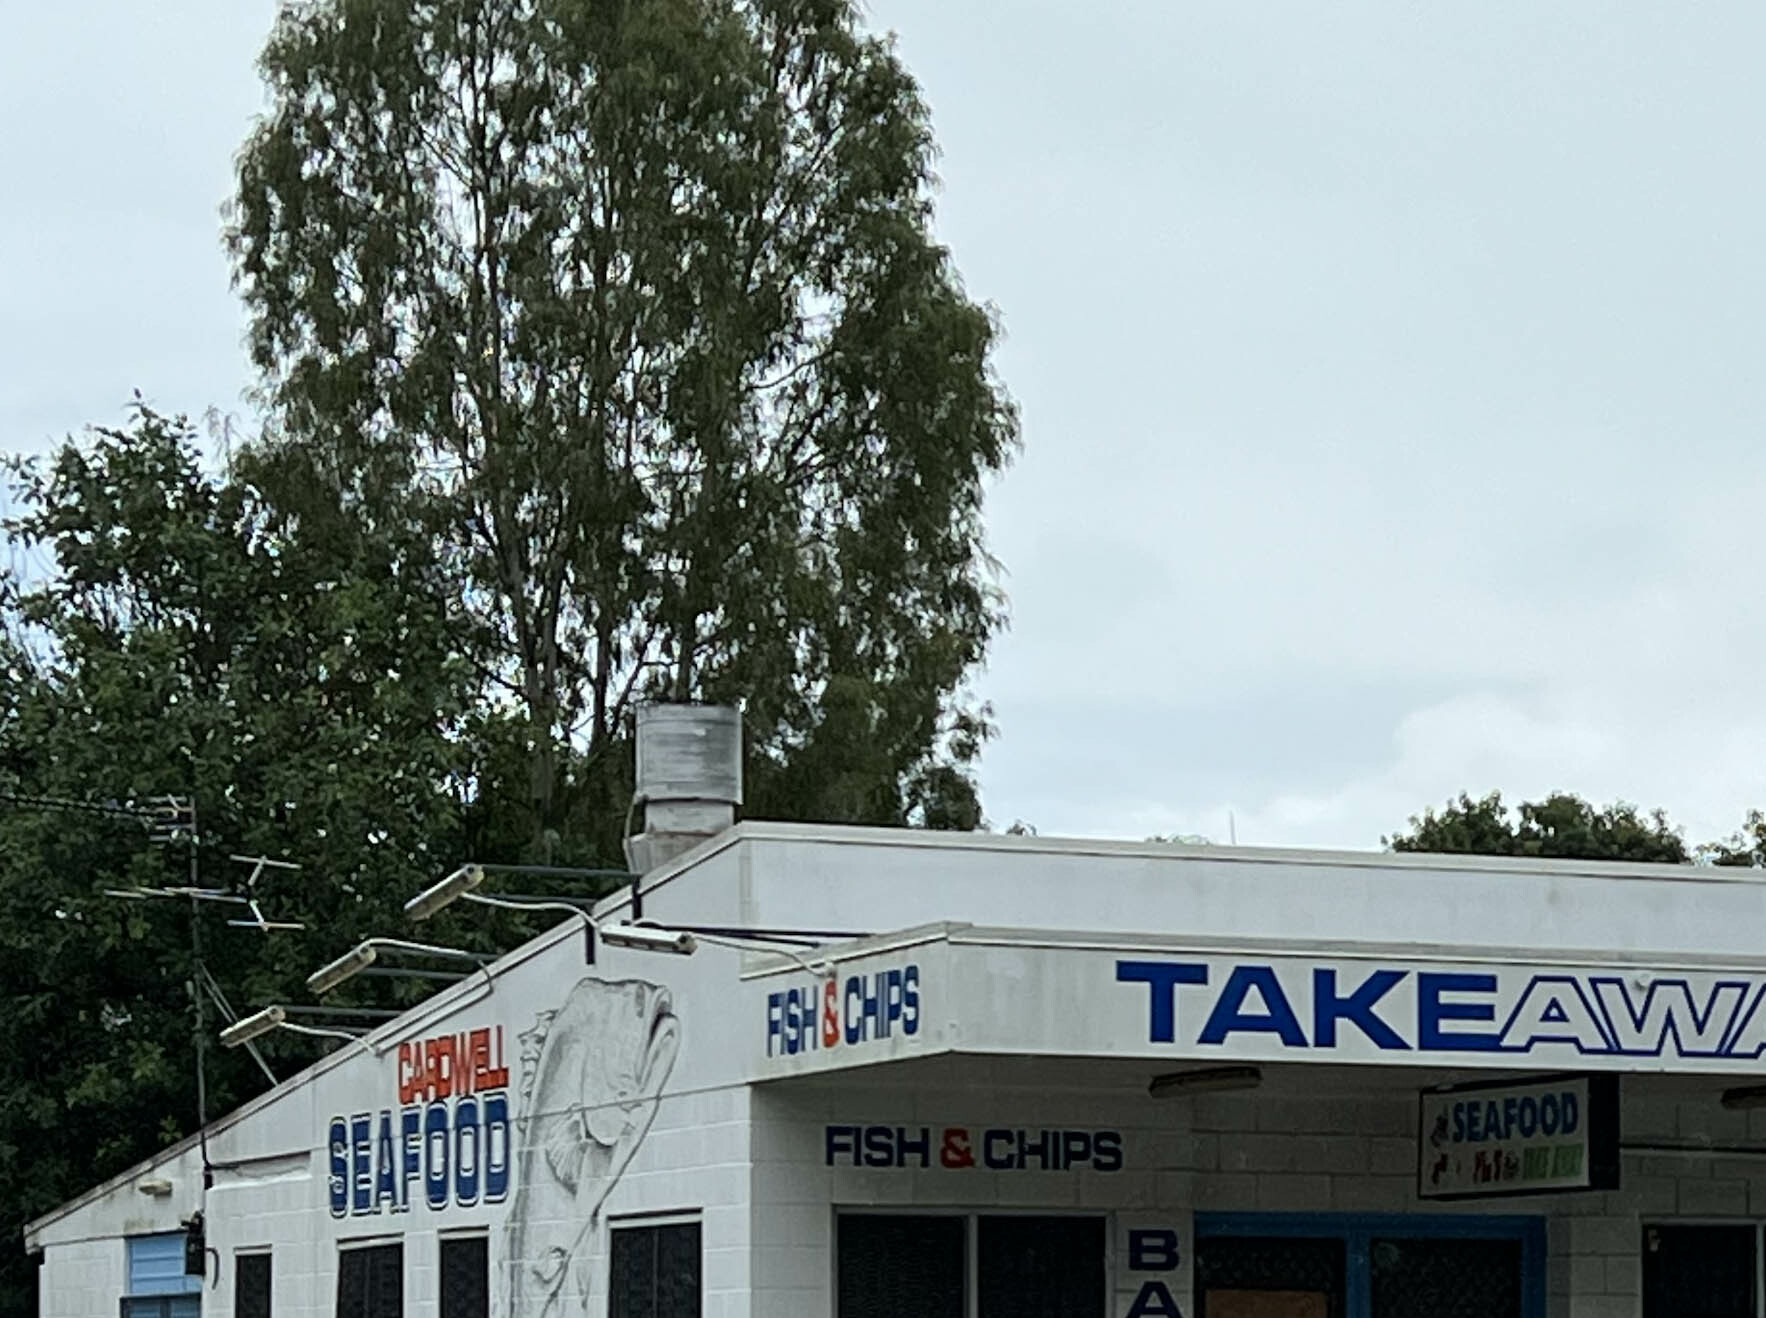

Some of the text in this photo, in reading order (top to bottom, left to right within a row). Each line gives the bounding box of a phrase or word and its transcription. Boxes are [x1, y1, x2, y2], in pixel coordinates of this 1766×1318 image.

[767, 965, 919, 1056] FISH & CHIPS
[399, 1026, 509, 1105] CARDWELL
[328, 1091, 511, 1219] SEAFOOD
[825, 1126, 1123, 1171] FISH & CHIPS
[1453, 1092, 1578, 1142] SEAFOOD
